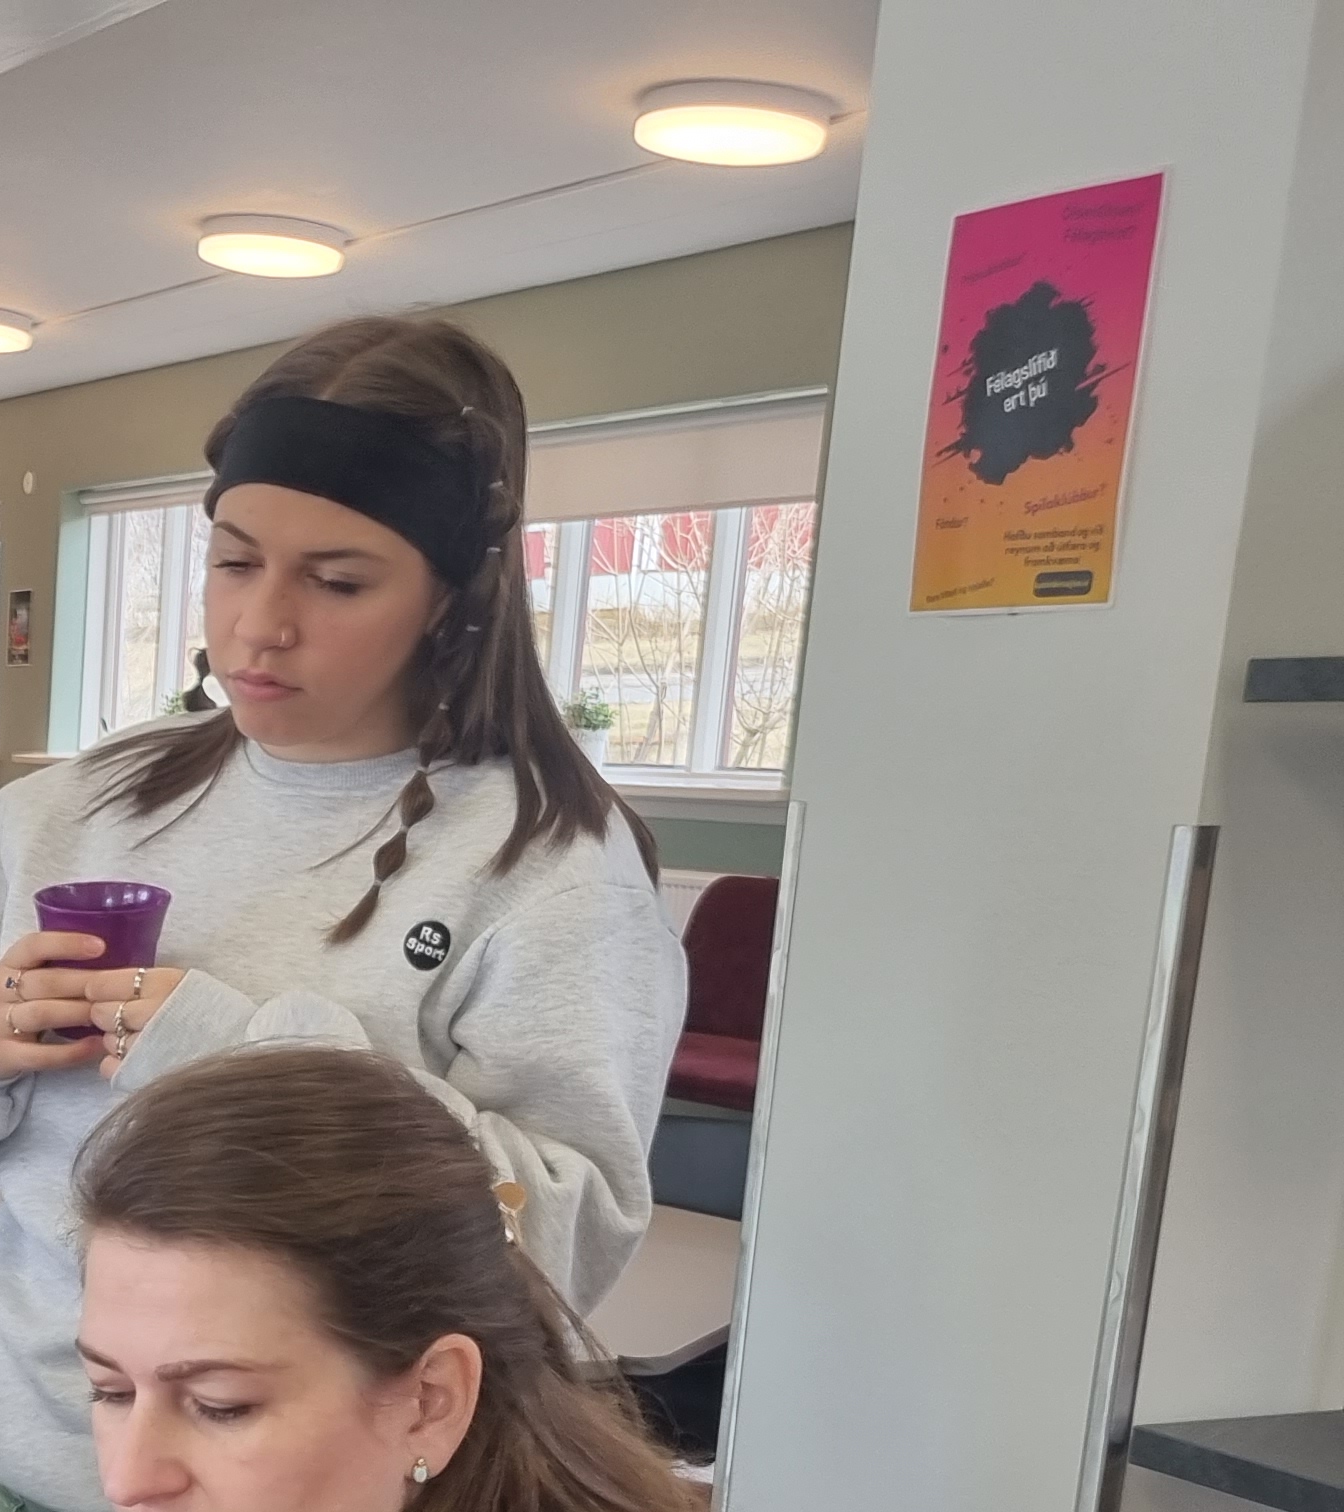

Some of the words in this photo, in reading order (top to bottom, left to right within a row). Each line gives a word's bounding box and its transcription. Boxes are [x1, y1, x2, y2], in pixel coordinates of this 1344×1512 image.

[985, 349, 1059, 398] Félagslífið
[1003, 391, 1027, 414] ert
[1027, 379, 1048, 408] þú
